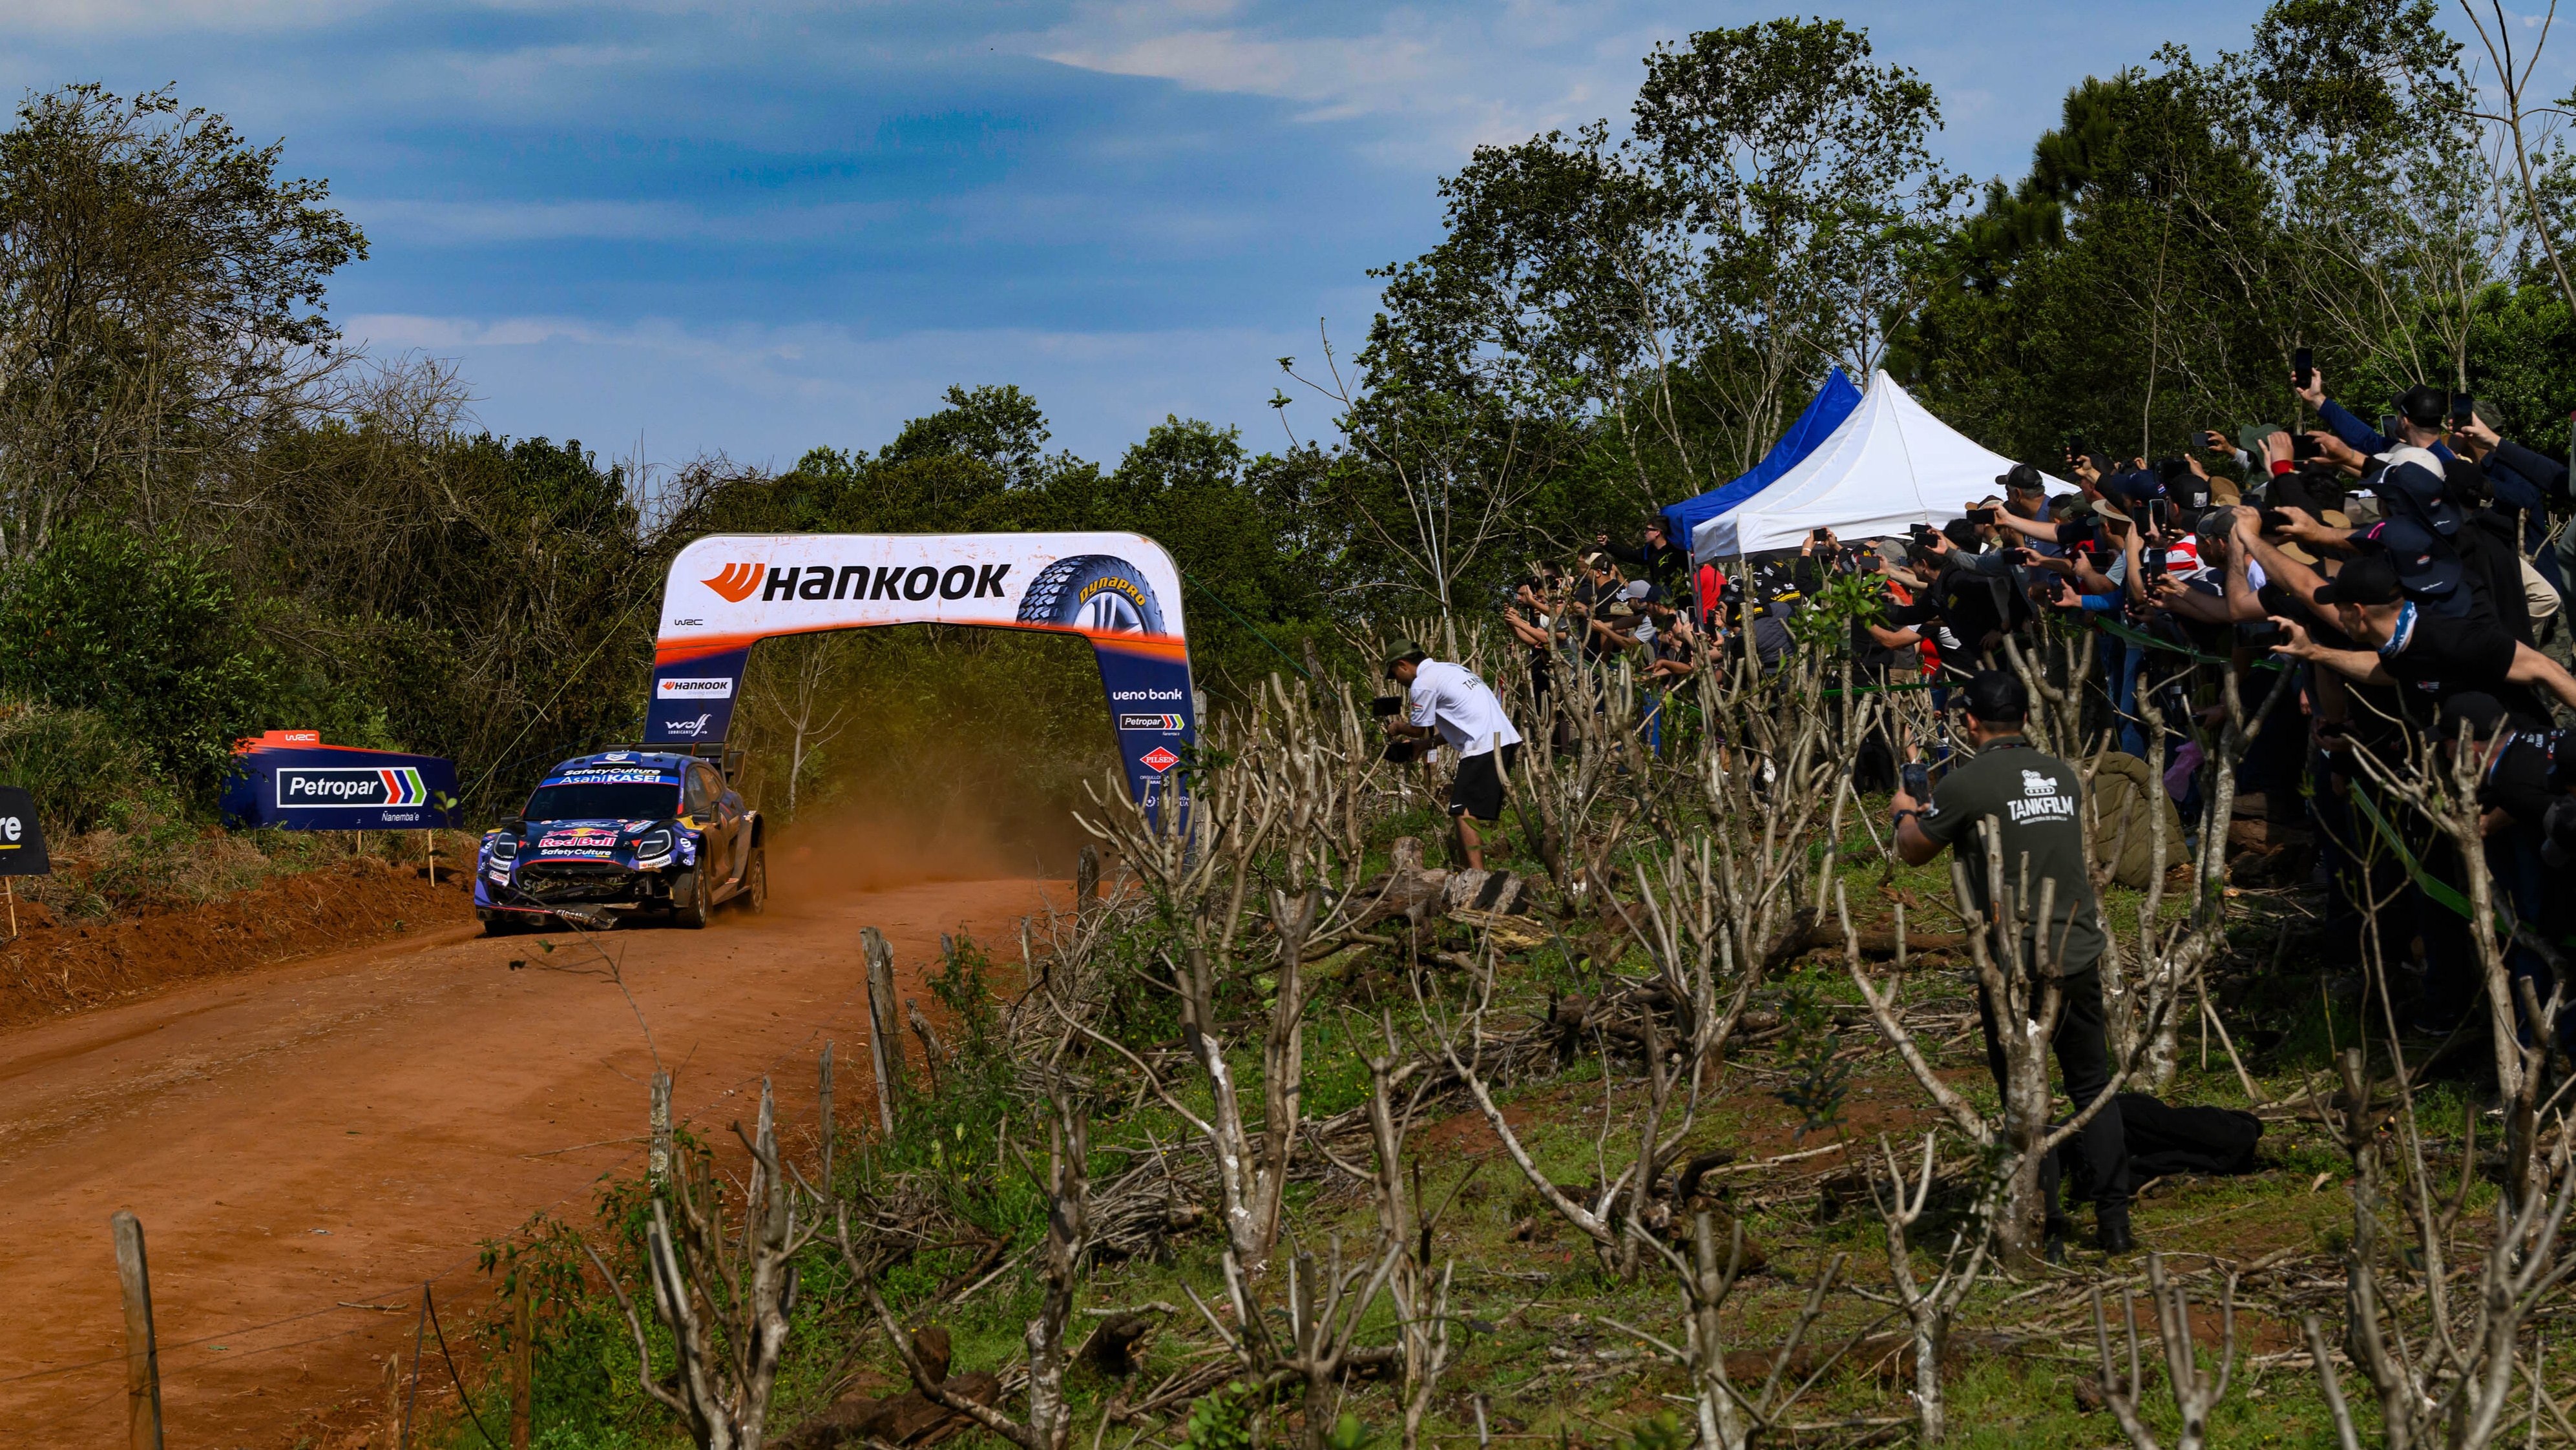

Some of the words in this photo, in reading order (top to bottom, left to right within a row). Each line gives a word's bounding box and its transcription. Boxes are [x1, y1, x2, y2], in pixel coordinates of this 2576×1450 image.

[1113, 691, 1147, 700] ueno
[1149, 689, 1182, 700] bank
[1124, 718, 1162, 727] Petropar
[289, 777, 379, 800] Petropar
[2007, 795, 2075, 821] TANKFILM
[538, 837, 576, 847] Red
[577, 837, 617, 847] Bull
